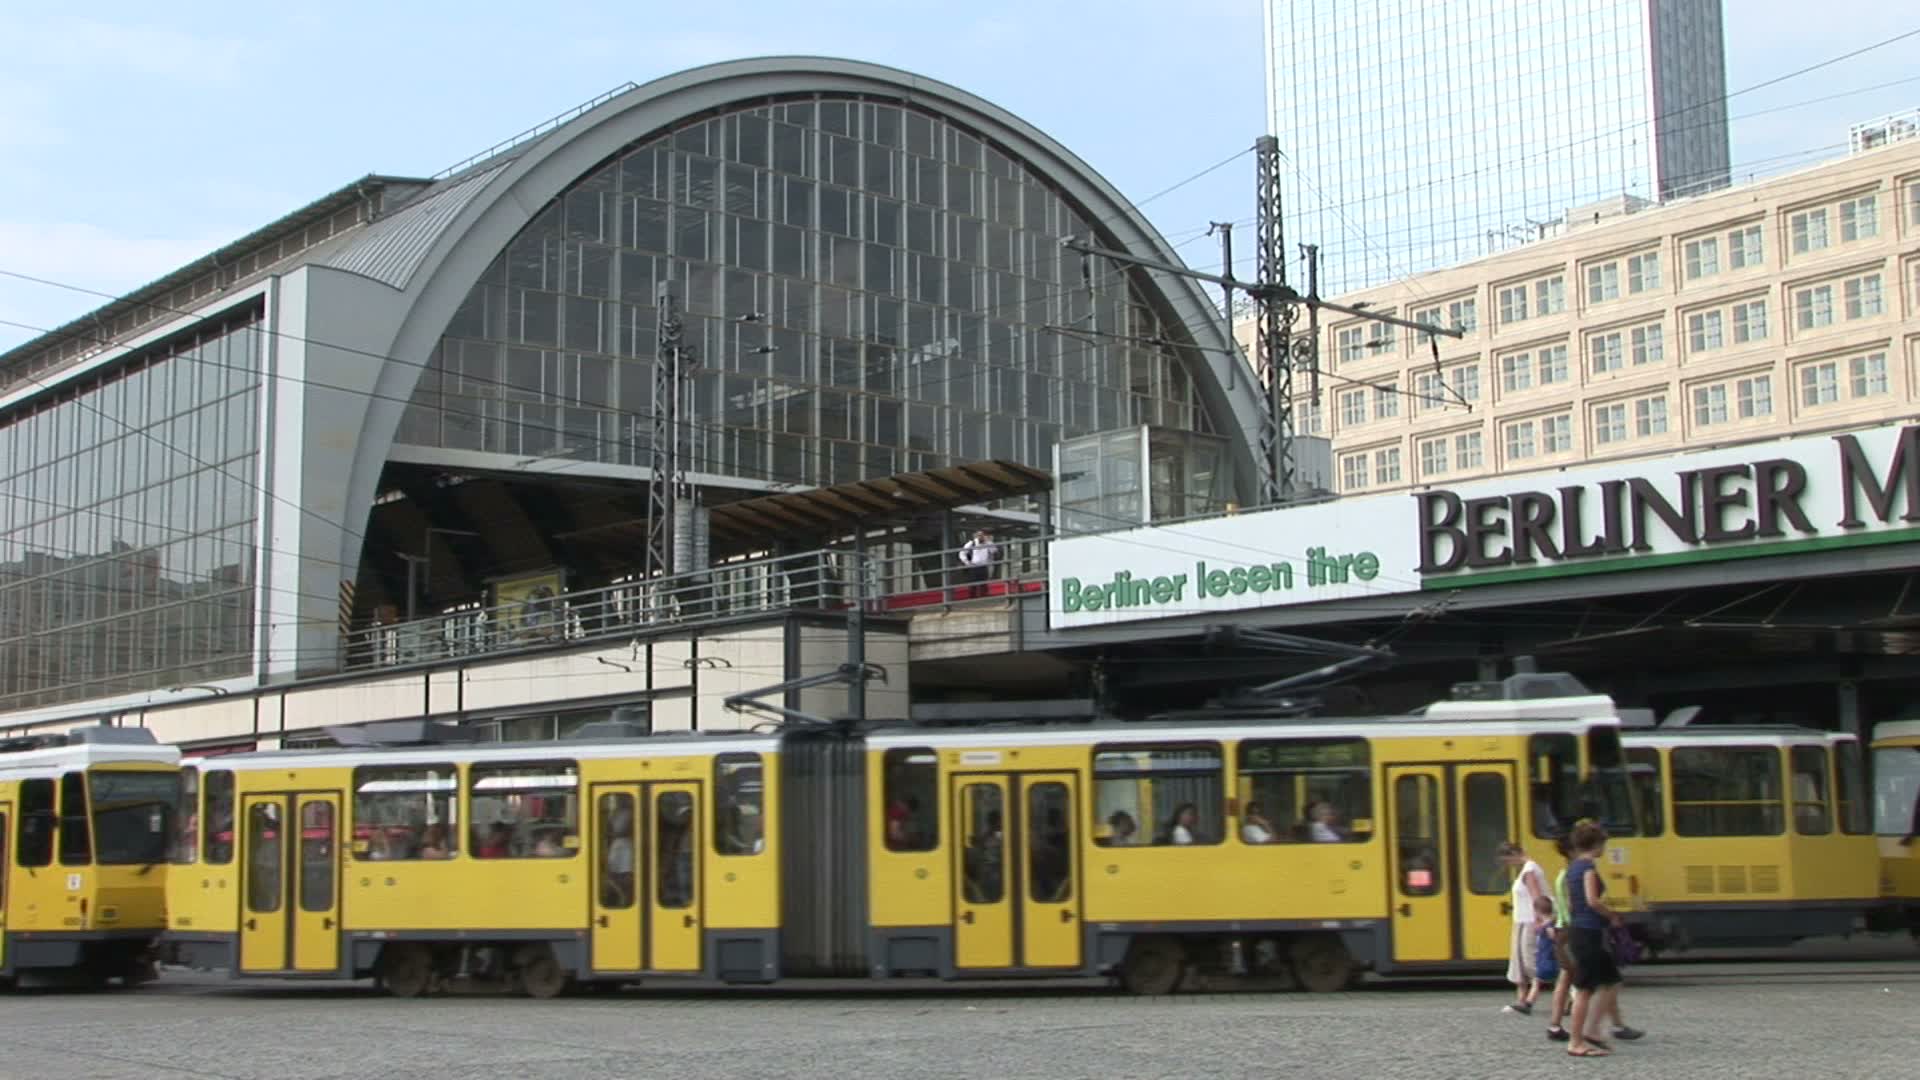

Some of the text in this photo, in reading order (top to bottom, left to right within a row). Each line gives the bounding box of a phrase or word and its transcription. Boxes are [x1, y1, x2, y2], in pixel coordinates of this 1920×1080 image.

[1412, 458, 1818, 574] BERLINER
[1062, 546, 1379, 613] Berliner lesen ihre
